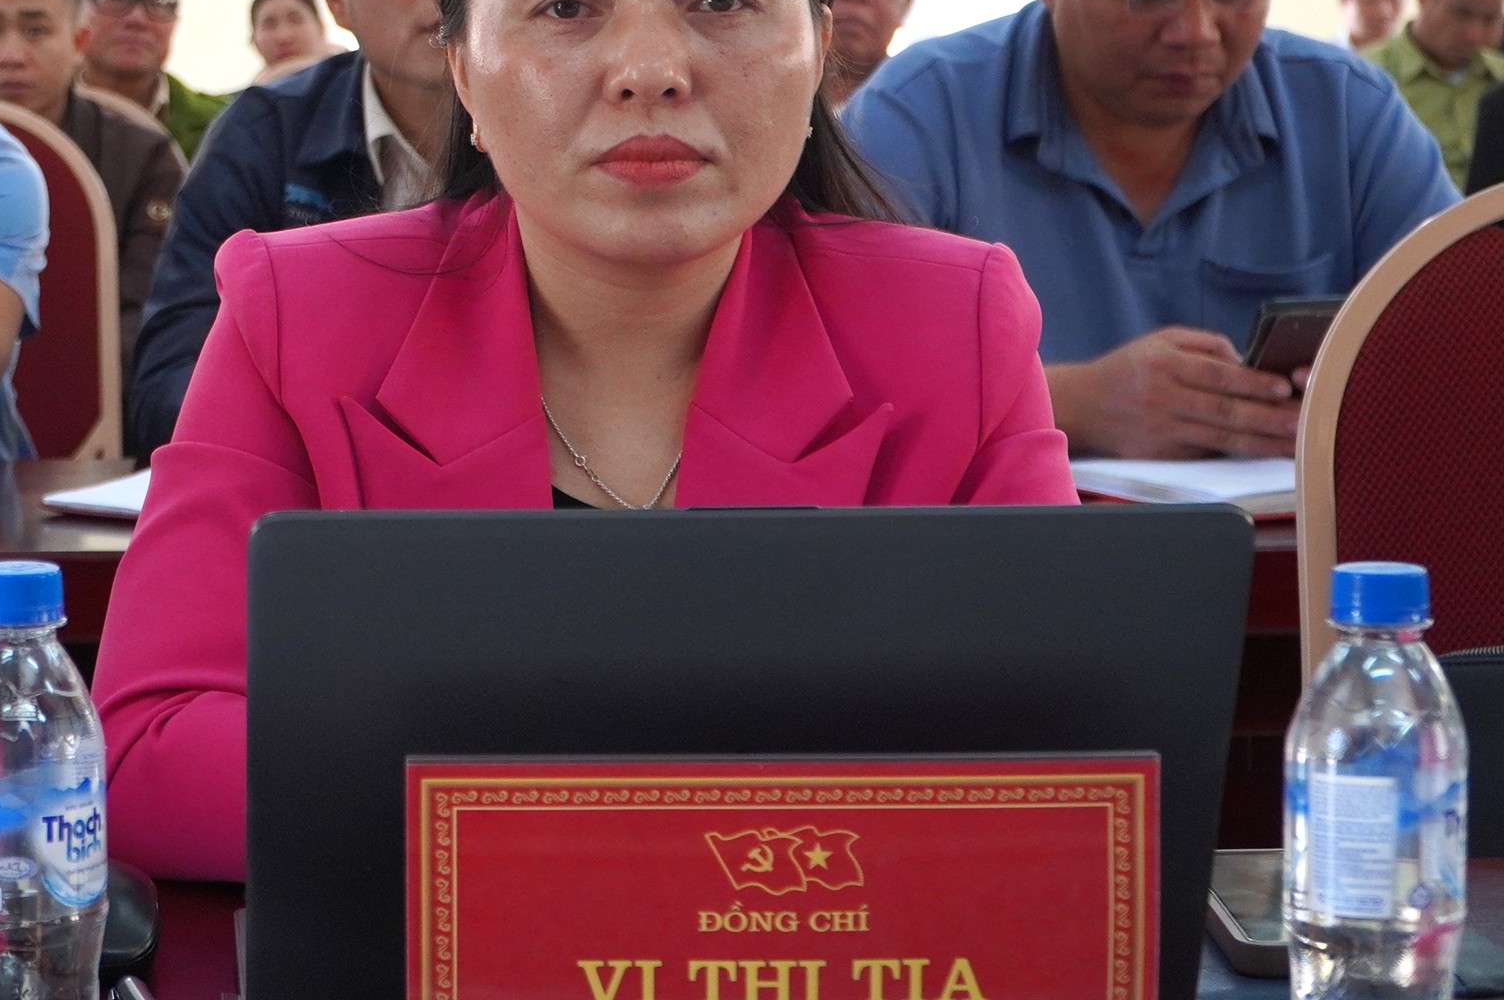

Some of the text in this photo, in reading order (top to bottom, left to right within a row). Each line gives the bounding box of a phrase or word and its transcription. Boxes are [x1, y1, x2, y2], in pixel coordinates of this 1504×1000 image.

[698, 901, 870, 932] ĐỒNG CHÍ
[577, 959, 663, 1000] VI
[852, 957, 989, 1000] TIA
